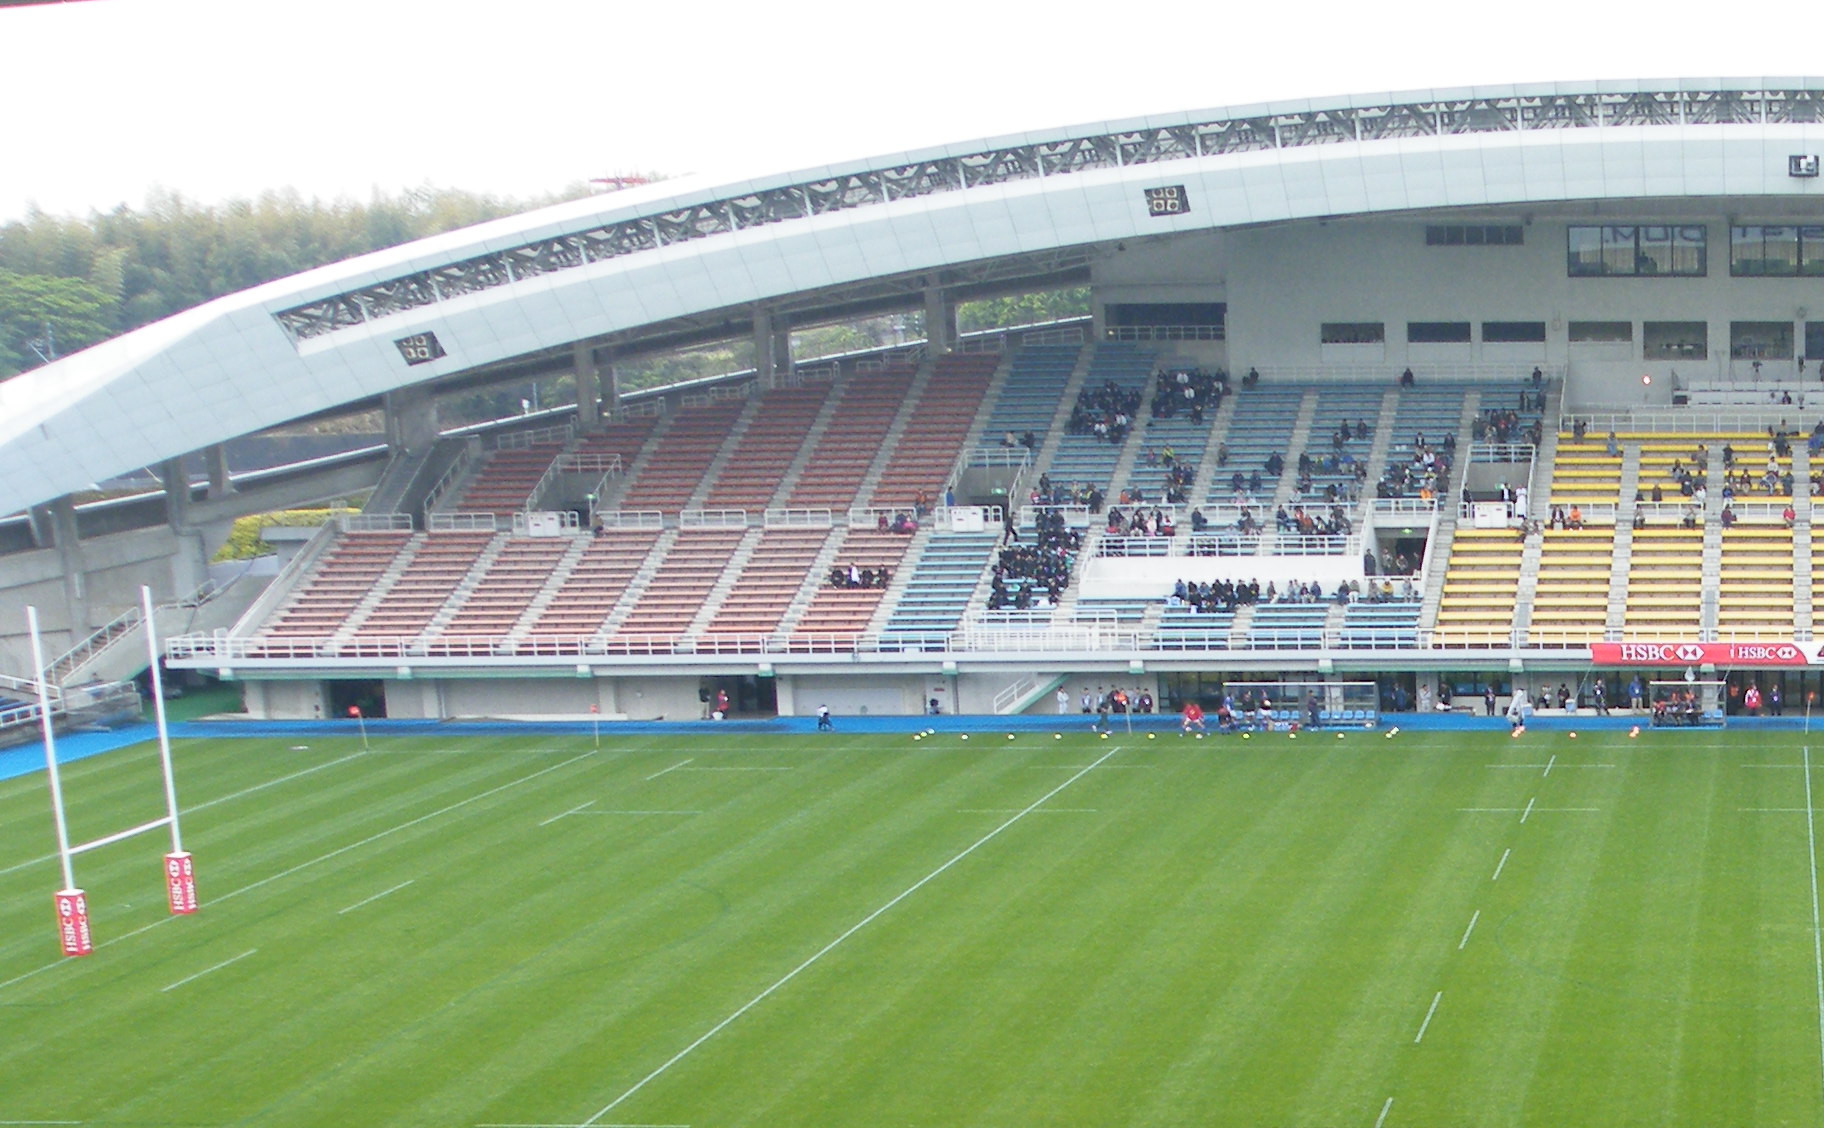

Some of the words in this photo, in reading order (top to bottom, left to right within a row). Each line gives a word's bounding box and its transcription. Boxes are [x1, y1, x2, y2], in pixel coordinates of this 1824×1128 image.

[1620, 644, 1676, 661] HSBC
[1738, 646, 1777, 661] HSBC
[171, 877, 185, 911] HSBC
[62, 917, 78, 952] HSBC
